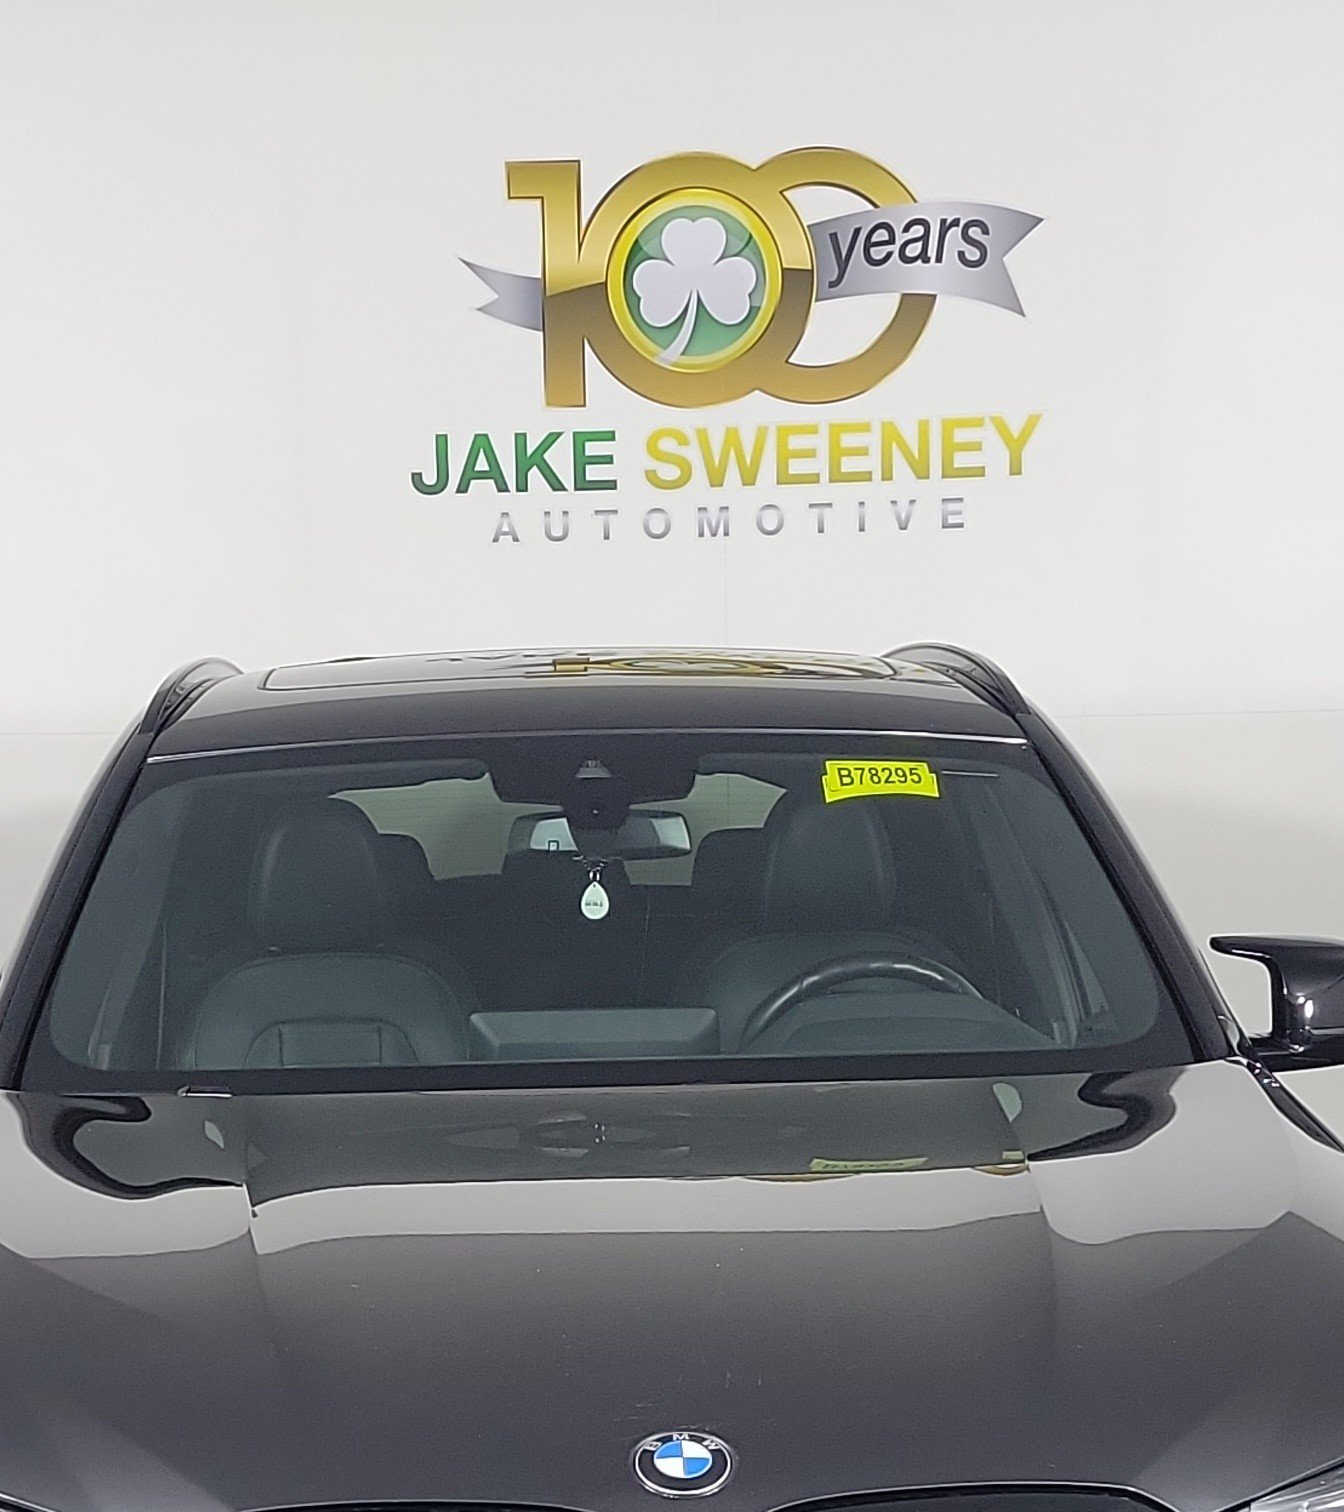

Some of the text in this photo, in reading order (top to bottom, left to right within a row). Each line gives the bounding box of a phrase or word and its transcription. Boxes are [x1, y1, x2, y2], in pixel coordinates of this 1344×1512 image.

[504, 146, 992, 409] 100 years
[410, 413, 1044, 496] JAKE SWEENEY
[491, 497, 966, 544] AUTOMOTIVE
[836, 767, 923, 787] B78295
